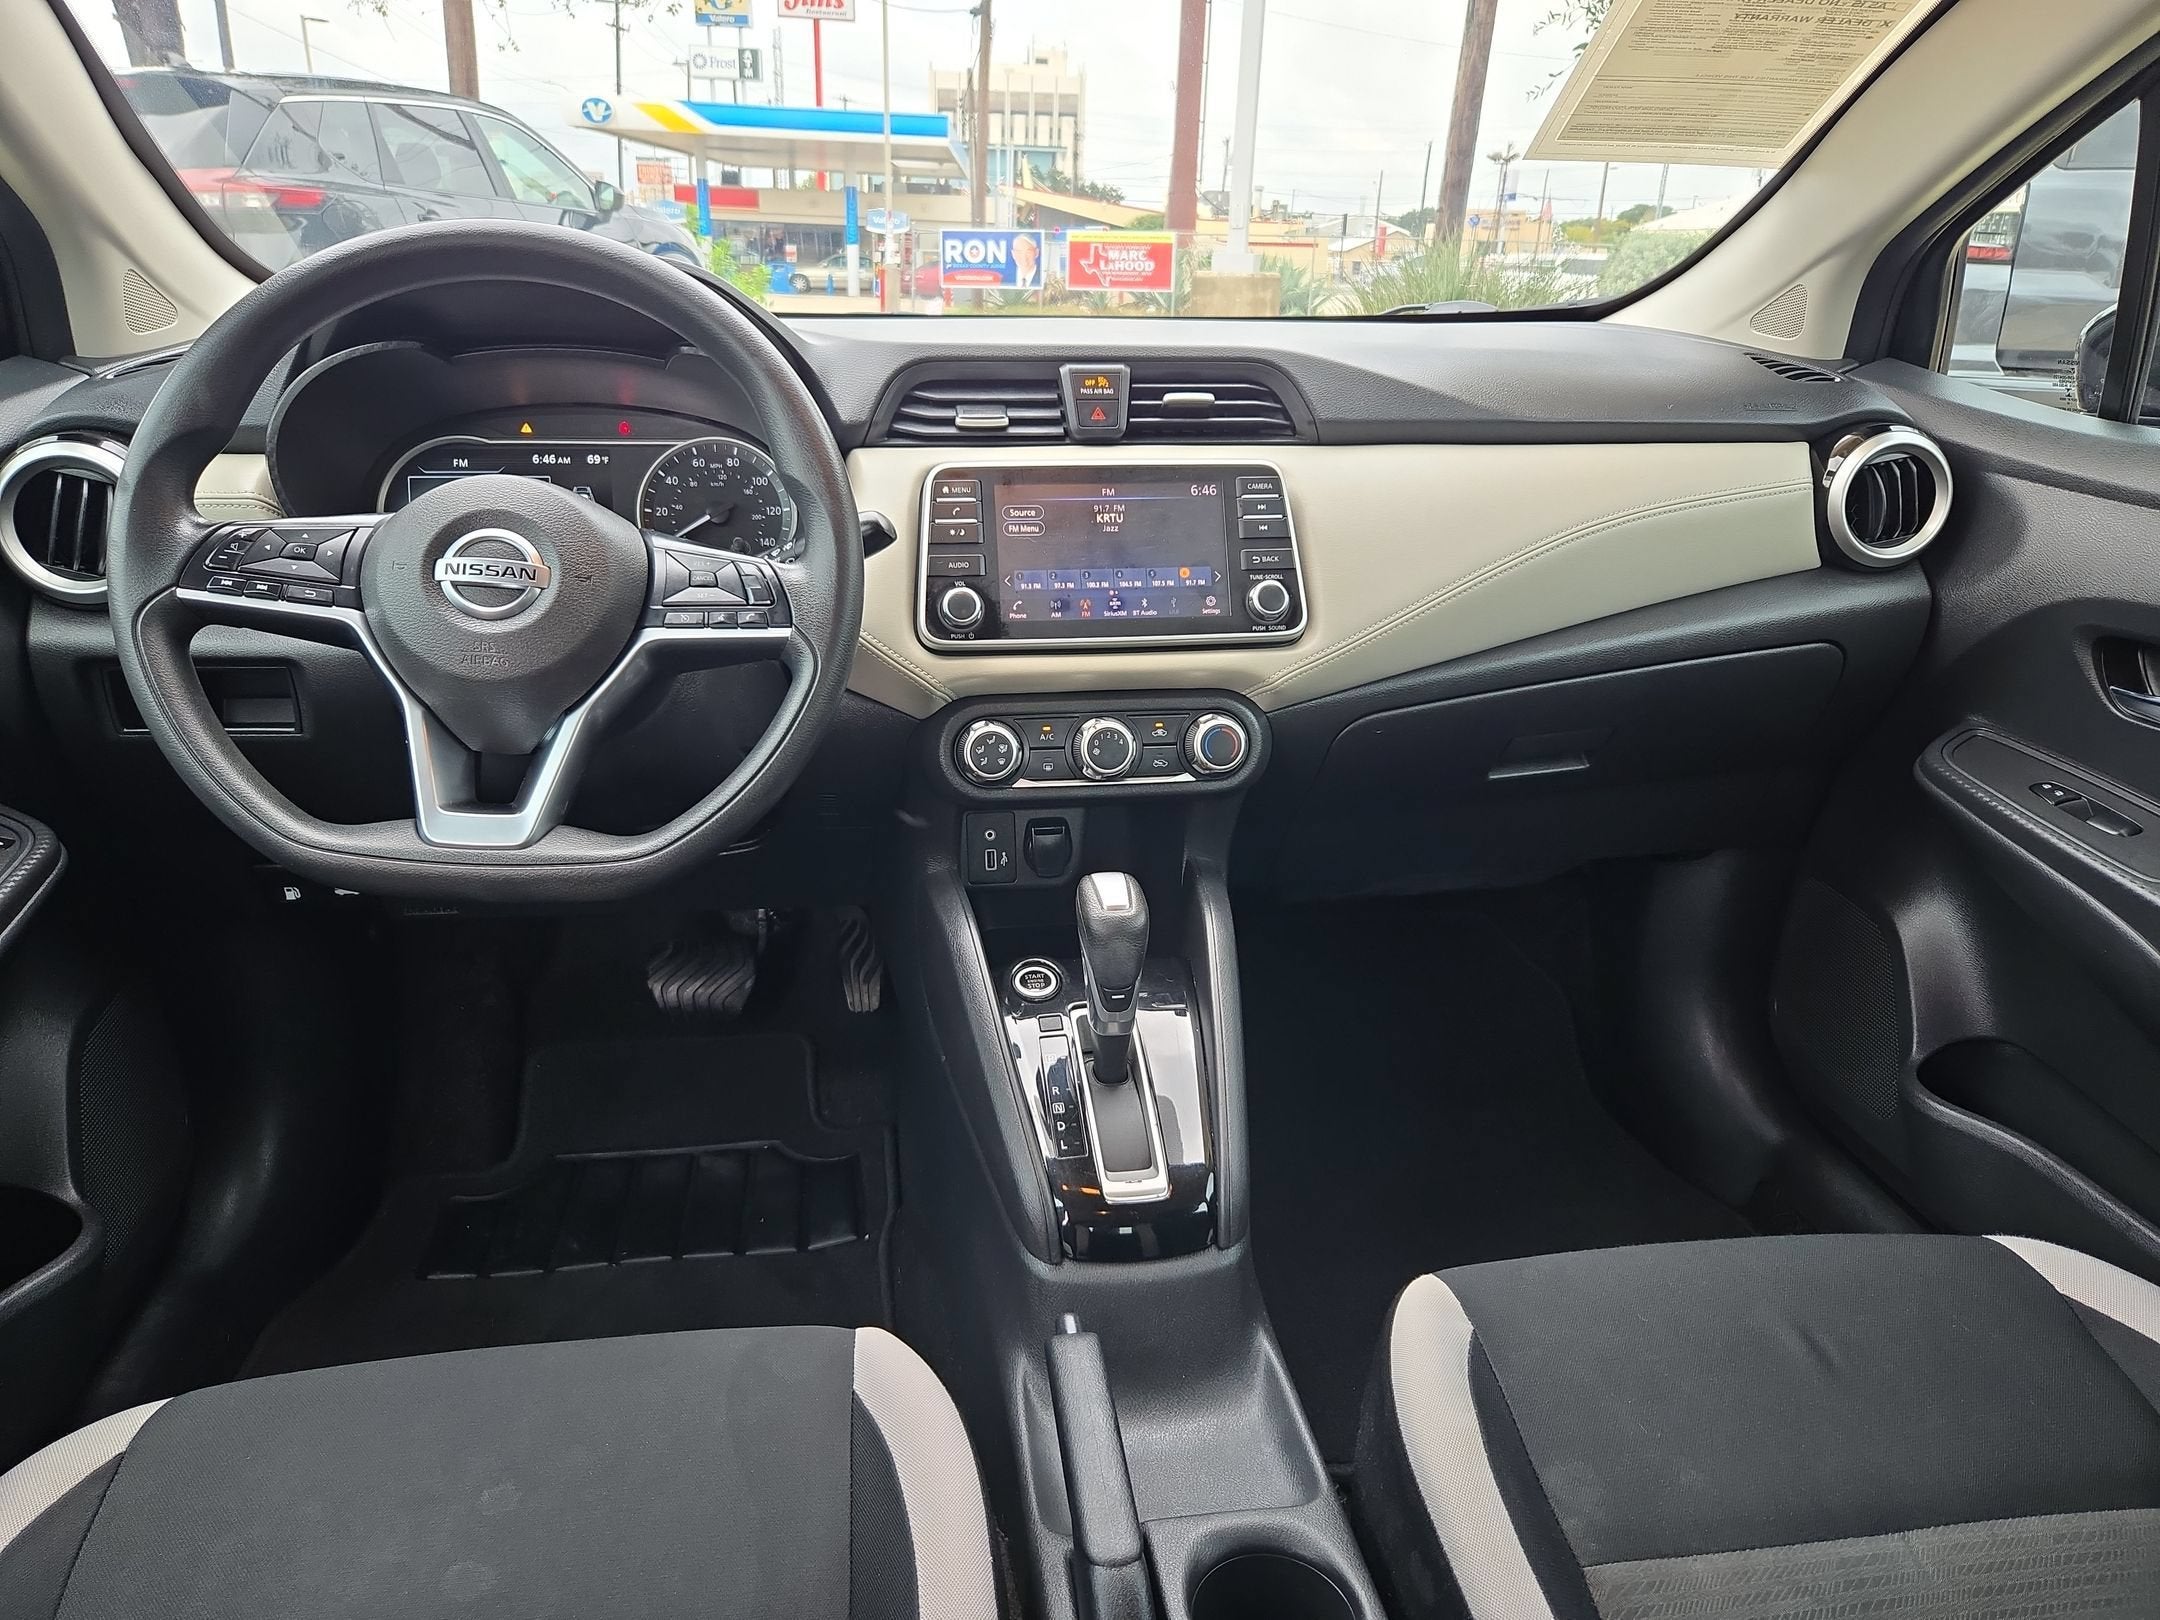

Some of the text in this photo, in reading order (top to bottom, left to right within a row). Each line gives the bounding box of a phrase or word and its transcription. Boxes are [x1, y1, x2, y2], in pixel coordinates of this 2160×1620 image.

[710, 56, 736, 69] Frost
[944, 240, 1007, 264] RON
[1107, 250, 1148, 261] MARC
[453, 459, 469, 468] FM
[532, 454, 556, 464] 6:46
[558, 456, 571, 464] AM
[692, 458, 705, 468] 60
[726, 458, 740, 467] 80
[665, 476, 679, 485] 40
[752, 477, 768, 486] 100
[952, 486, 971, 494] MENU
[1101, 488, 1115, 497] FM
[1190, 484, 1217, 496] 6:46
[656, 508, 668, 517] 20
[766, 507, 781, 516] 120
[1009, 508, 1036, 517] Source
[1093, 504, 1126, 513] 91.7 FM
[1096, 513, 1124, 523] KRTU
[1008, 524, 1040, 533] FM Menu
[760, 538, 775, 547] 140
[294, 547, 307, 555] OK
[948, 561, 970, 569] AUDIO
[444, 562, 537, 581] NISSAN
[1202, 608, 1221, 616] Settings
[462, 654, 510, 667] AIRBAG
[1106, 731, 1111, 739] 2
[1052, 1087, 1060, 1095] R
[1055, 1104, 1064, 1113] N
[1057, 1121, 1066, 1131] D
[1060, 1140, 1068, 1150] L
